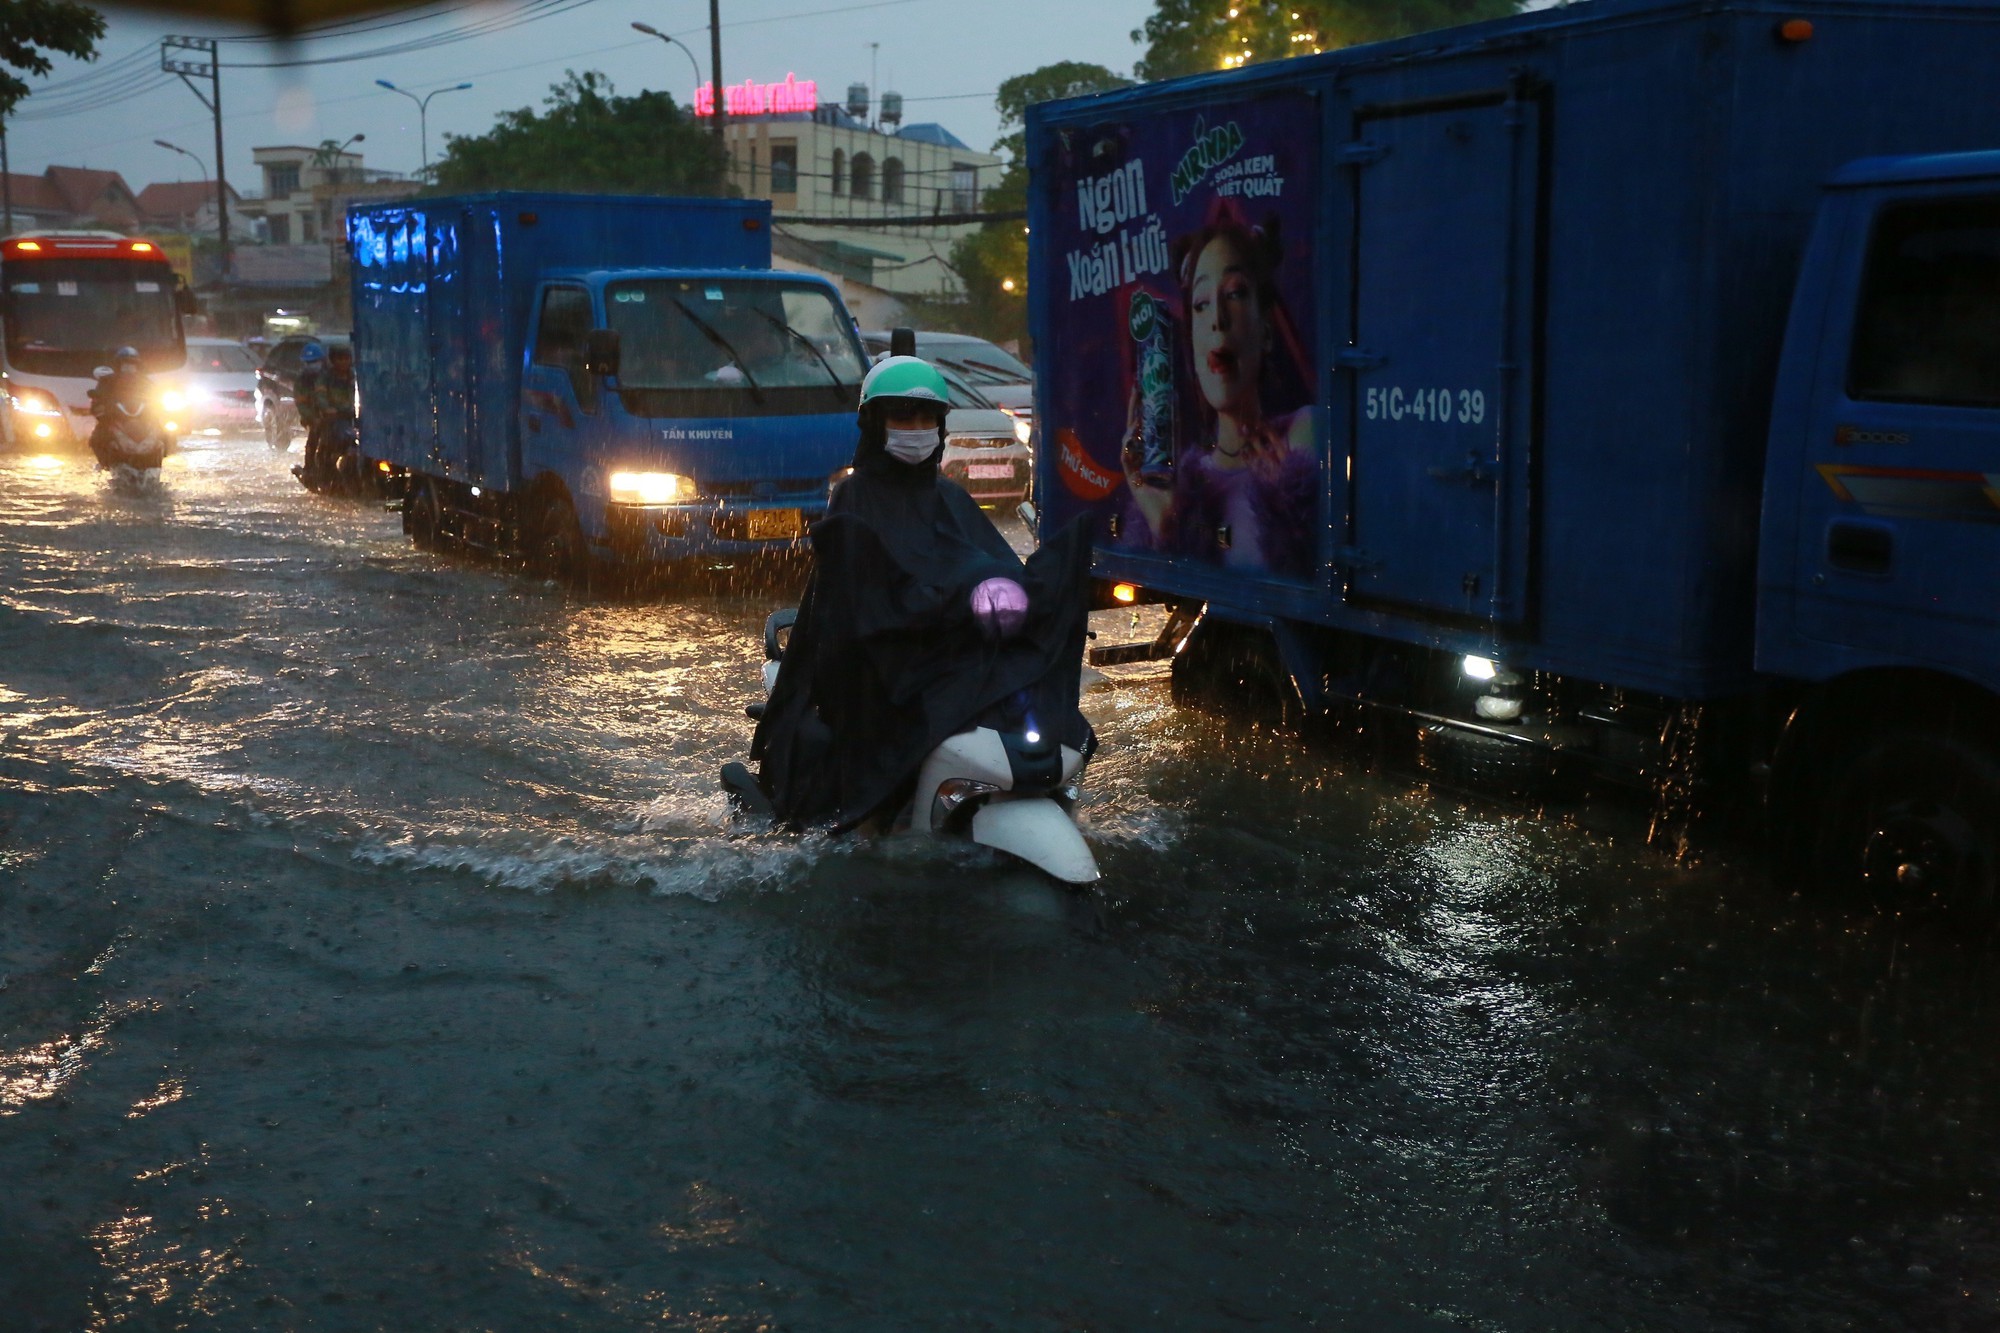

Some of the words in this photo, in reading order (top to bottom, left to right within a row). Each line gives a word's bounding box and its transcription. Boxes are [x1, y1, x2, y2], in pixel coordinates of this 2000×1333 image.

[1170, 118, 1244, 207] MIRINDA
[1215, 161, 1243, 183] SODA
[1244, 154, 1274, 175] KEM
[1076, 158, 1147, 234] Ngon
[1216, 179, 1242, 199] VIỆT
[1243, 172, 1285, 199] QUẤT
[1066, 243, 1120, 301] Xoắn
[1120, 213, 1169, 283] Lưỡi
[1458, 388, 1485, 424] 39
[1080, 464, 1111, 488] NGAY
